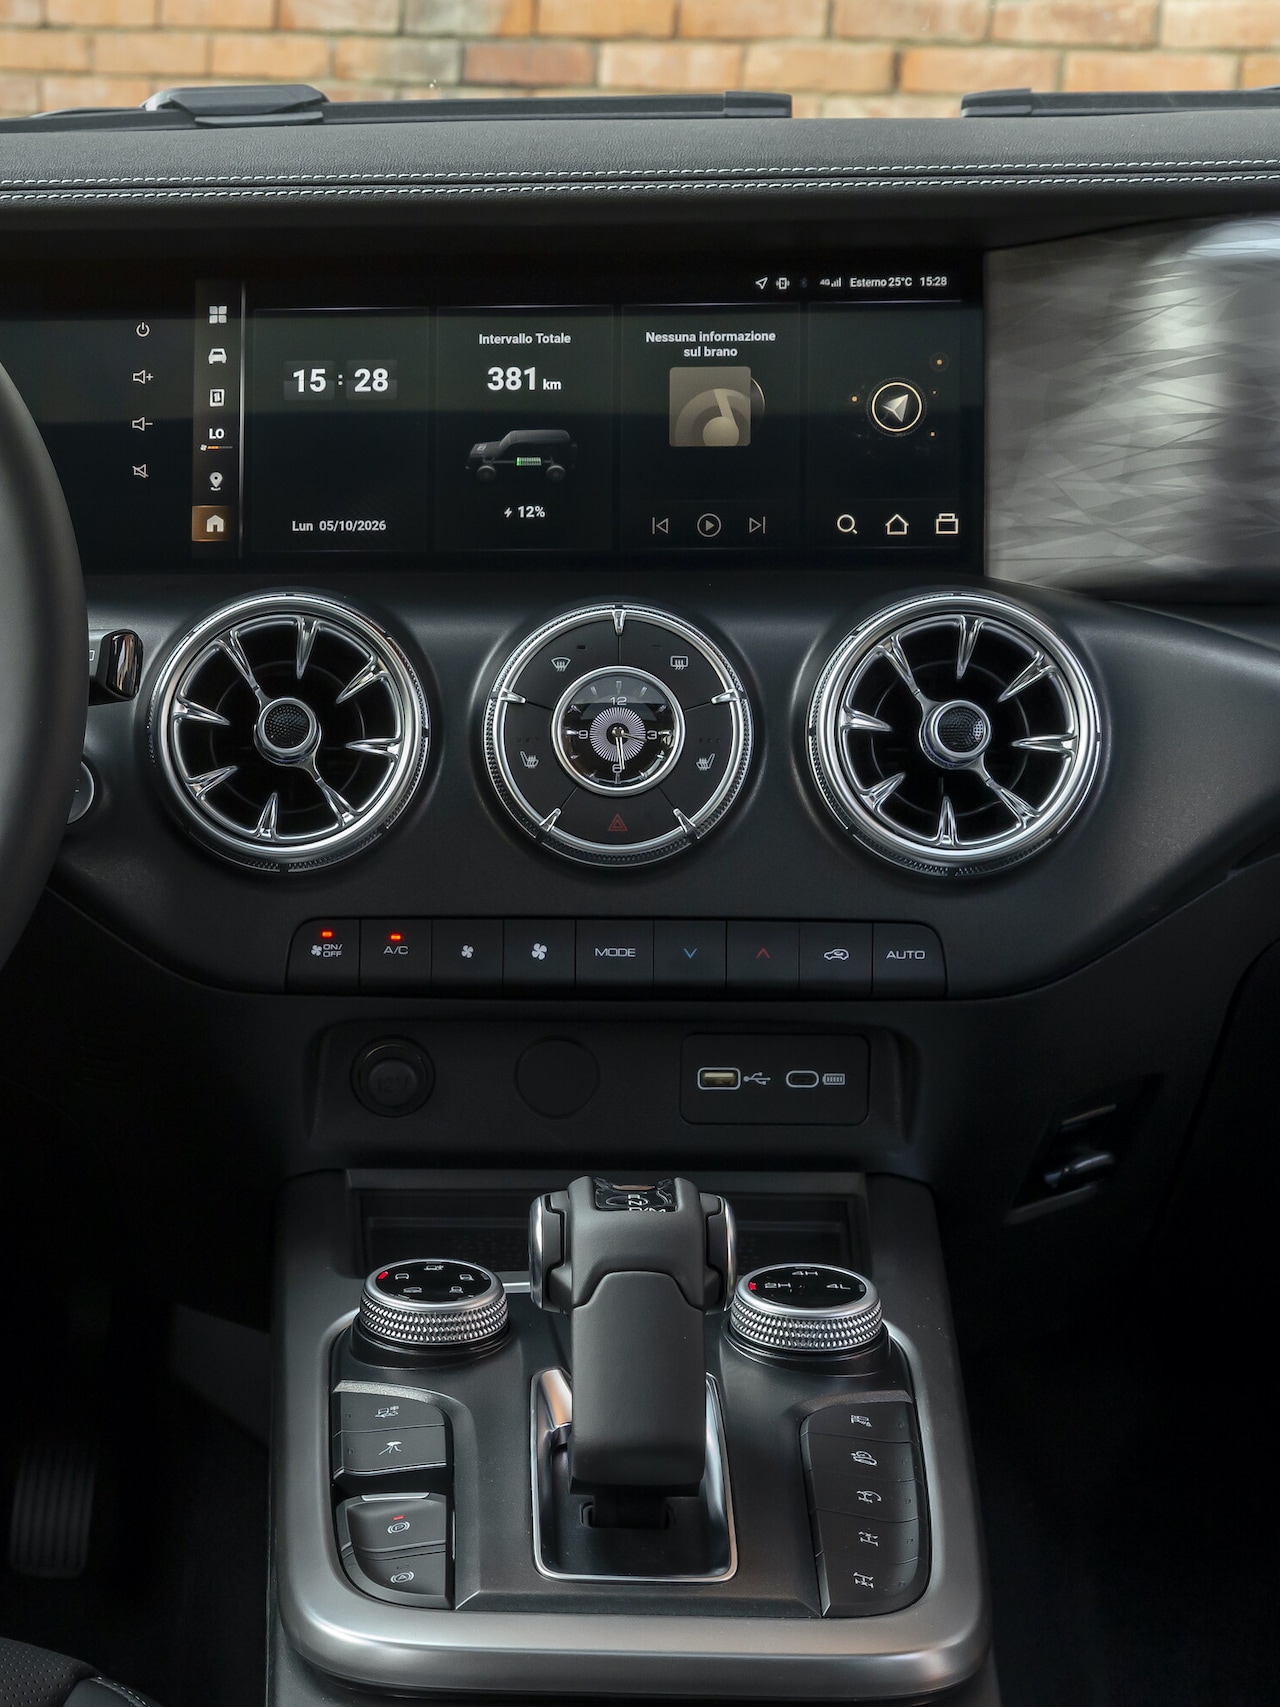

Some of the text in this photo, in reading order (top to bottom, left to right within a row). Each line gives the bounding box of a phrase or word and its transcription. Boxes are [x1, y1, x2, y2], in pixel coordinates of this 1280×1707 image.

[819, 278, 831, 286] 4G
[849, 276, 948, 288] Esterno 25°C 15:28
[478, 332, 572, 345] Intervallo Totale
[645, 330, 776, 343] Nessuna informazione
[683, 345, 738, 358] sul brano
[487, 366, 562, 391] 381 km
[208, 428, 225, 440] LO
[517, 505, 546, 518] 12%
[292, 519, 387, 533] Lun 05/10/2026
[609, 696, 628, 706] 12
[577, 729, 589, 740] 9
[646, 730, 659, 740] 3
[611, 763, 624, 774] 6
[322, 943, 343, 951] ON/
[383, 945, 409, 955] A/C
[594, 947, 637, 958] MODE
[322, 950, 342, 958] OFF
[885, 950, 926, 960] AUTO
[826, 1283, 851, 1291] 4L
